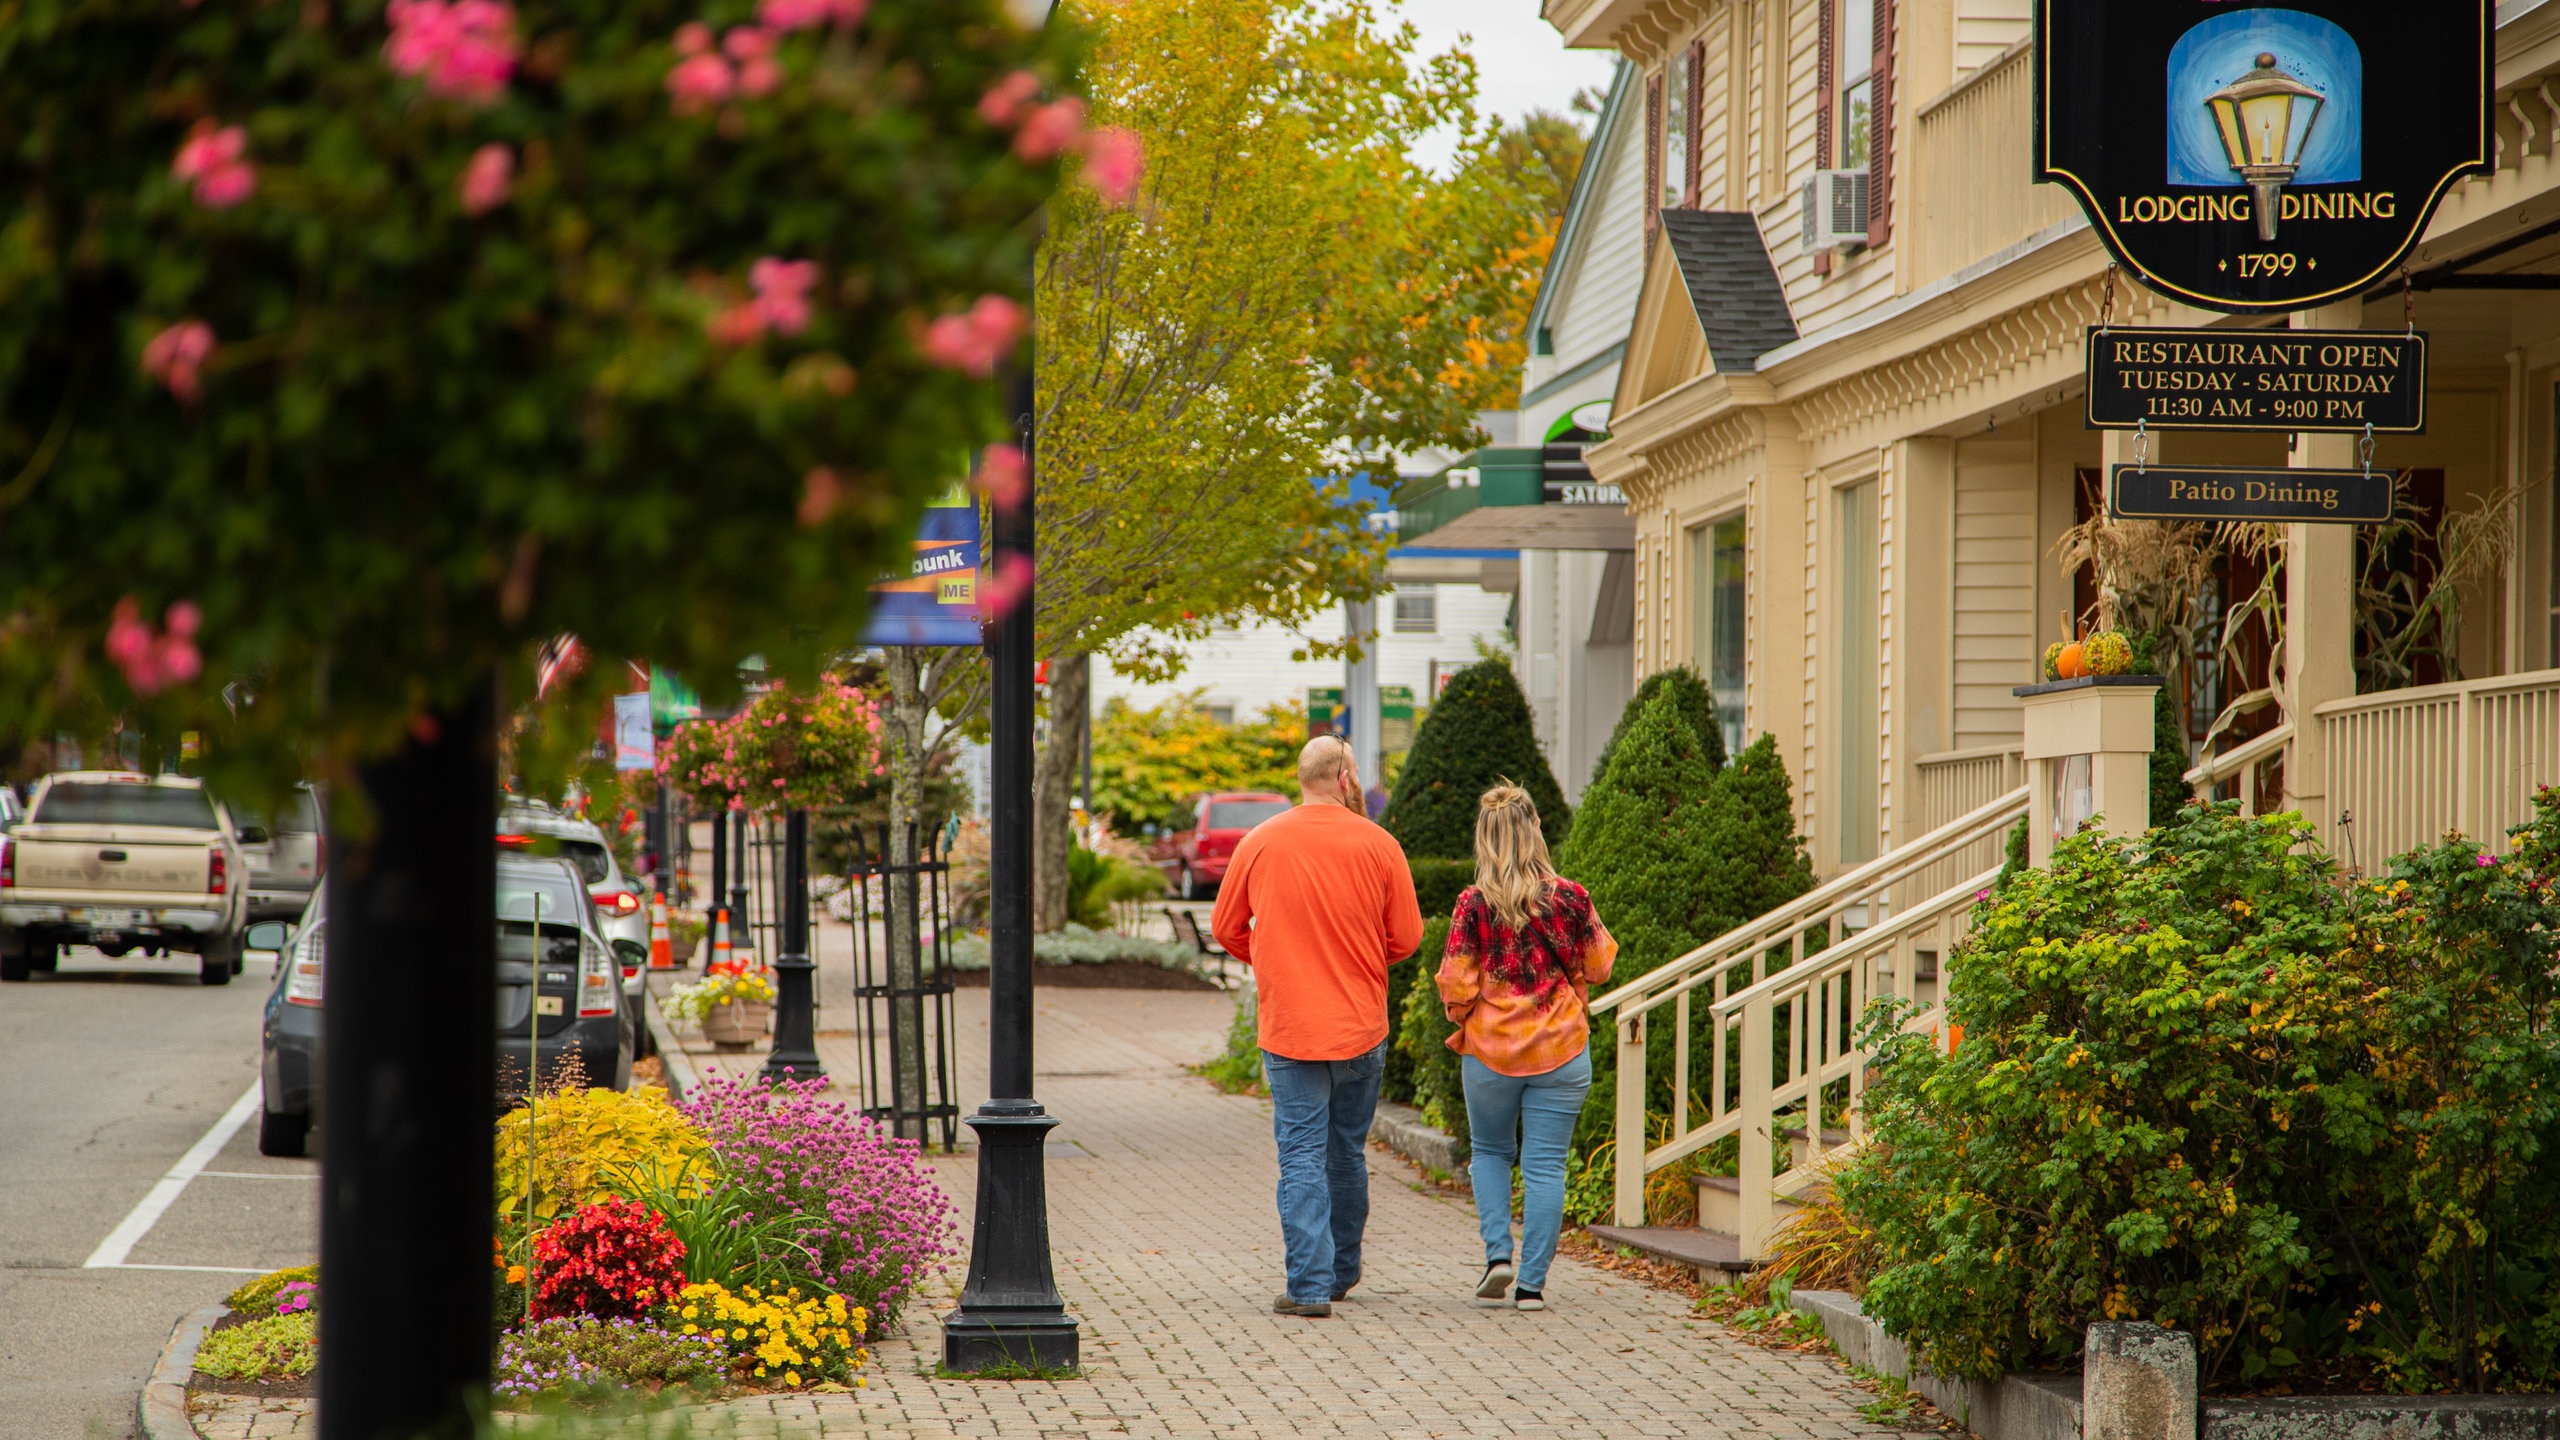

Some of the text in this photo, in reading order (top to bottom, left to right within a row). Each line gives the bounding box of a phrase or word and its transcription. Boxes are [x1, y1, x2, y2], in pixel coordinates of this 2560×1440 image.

[2120, 192, 2395, 222] LODGING DINING
[2237, 253, 2297, 278] 1799
[2114, 342, 2401, 367] RESTAURANT OPEN
[2119, 370, 2236, 391] TUESDAY
[2257, 374, 2395, 394] SATURDAY
[2147, 398, 2202, 417] 11:30
[2209, 399, 2253, 418] AM
[2274, 400, 2318, 419] 9:00
[2325, 401, 2364, 419] PM
[2169, 480, 2339, 510] Patio Dining
[944, 584, 970, 598] ME
